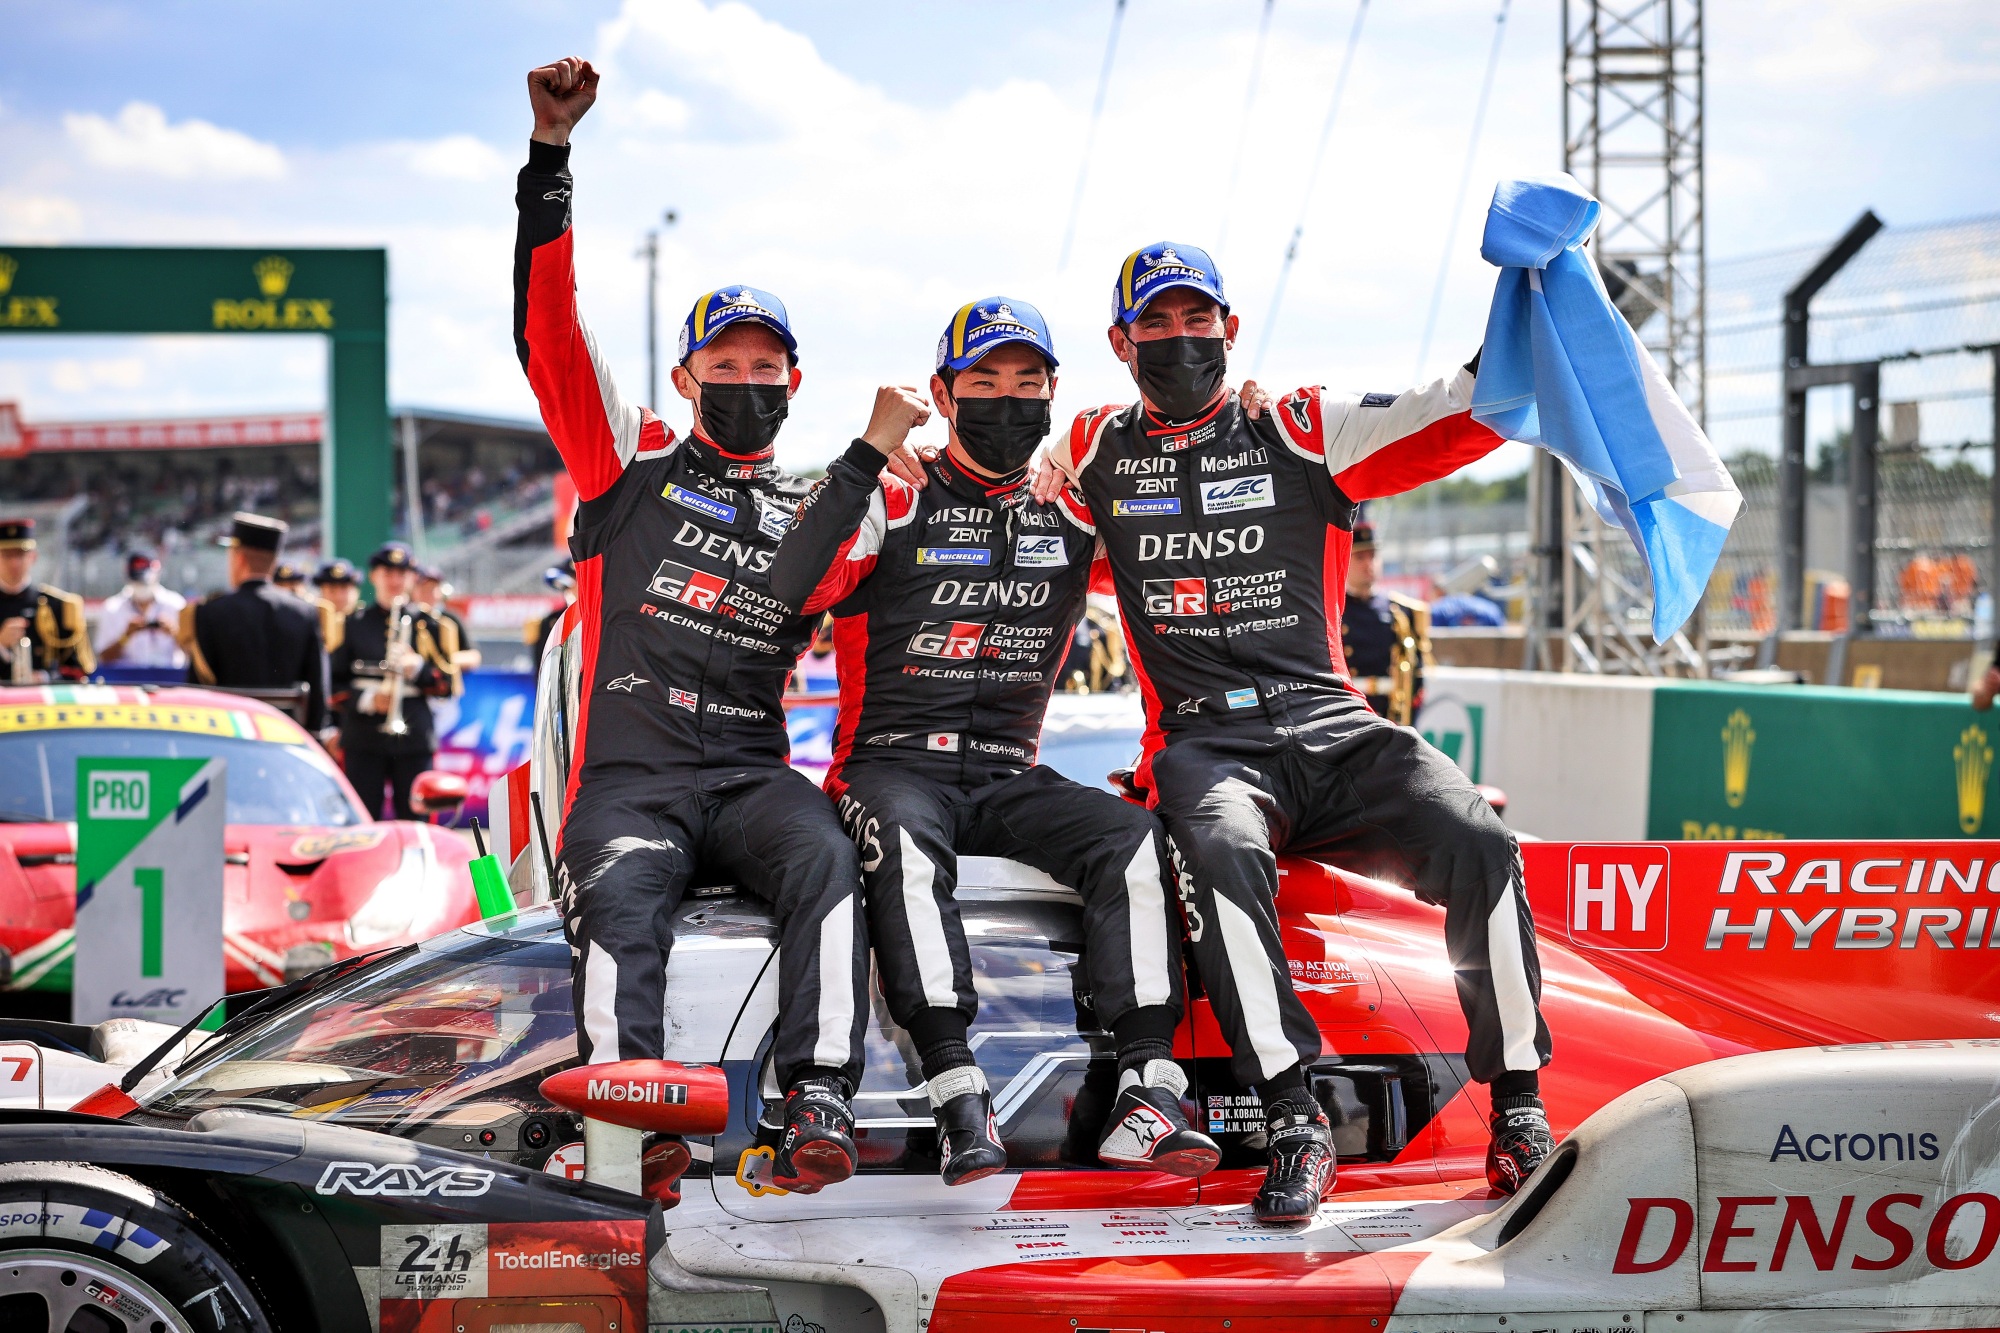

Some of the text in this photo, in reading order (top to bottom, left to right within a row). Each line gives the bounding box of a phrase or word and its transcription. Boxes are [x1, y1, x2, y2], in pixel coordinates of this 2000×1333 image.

[1135, 267, 1204, 291] MICHELIN
[0, 296, 60, 327] EX
[212, 299, 334, 328] ROLEX
[968, 324, 1038, 342] MICHELIN
[1189, 421, 1216, 436] TOYOTA
[1190, 426, 1215, 441] GAZOO
[1190, 432, 1216, 446] Racing
[1163, 440, 1189, 453] GR
[1201, 452, 1249, 472] Mobil
[697, 473, 738, 503] ZNT
[1136, 477, 1178, 494] ZENT
[1207, 478, 1268, 500] WEC
[682, 496, 730, 517] MICHELIN
[1130, 503, 1174, 511] MICHELIN
[949, 527, 993, 543] ZENT
[1138, 525, 1265, 561] DENSO
[673, 521, 776, 574] DENS
[939, 553, 984, 561] MICHELIN
[1017, 540, 1060, 554] WEC
[1212, 569, 1287, 590] TOYOTA
[653, 576, 717, 610] GR
[930, 580, 1050, 608] DENSO
[1146, 593, 1205, 614] GR
[1212, 583, 1283, 603] GAZOO
[724, 594, 784, 624] GAZOO
[1213, 595, 1282, 615] Racing
[640, 603, 780, 655] RACING HYBRID
[718, 603, 778, 636] Racing
[994, 623, 1054, 637] TOYOTA
[1153, 614, 1299, 638] RACING HYBRID
[911, 633, 977, 657] GR
[984, 636, 1046, 649] GAZOO
[981, 646, 1039, 662] Racing
[902, 664, 1043, 682] RACING HYBRID
[0, 707, 219, 730] errari
[94, 780, 145, 810] PRO
[1717, 851, 2000, 894] RACIN
[1574, 863, 1664, 931] HY
[134, 868, 163, 977] 1
[1704, 907, 2000, 949] HYBRI
[1306, 961, 1350, 972] ACTION
[1306, 971, 1332, 980] ROAD
[1335, 972, 1369, 981] SAFETY
[1, 1057, 34, 1081] 7
[588, 1080, 658, 1103] Mobil
[1225, 1096, 1235, 1106] M.
[1225, 1109, 1267, 1119] K. KOBAYA
[1225, 1122, 1266, 1132] J.M. LOPEZ
[1770, 1124, 1940, 1162] Acronis
[316, 1163, 495, 1195] RAYS
[0, 1213, 64, 1226] SPORT
[991, 1217, 1048, 1225] JTEKT
[1612, 1193, 2000, 1275] DENSO
[398, 1234, 472, 1272] 24h
[1015, 1241, 1069, 1249] NSK
[494, 1250, 641, 1270] TotalEnergies
[395, 1274, 467, 1285] LE MANS
[83, 1284, 114, 1305] GR
[120, 1293, 151, 1314] TOYOTA
[111, 1303, 140, 1322] Racing
[115, 1298, 145, 1318] GAZOO
